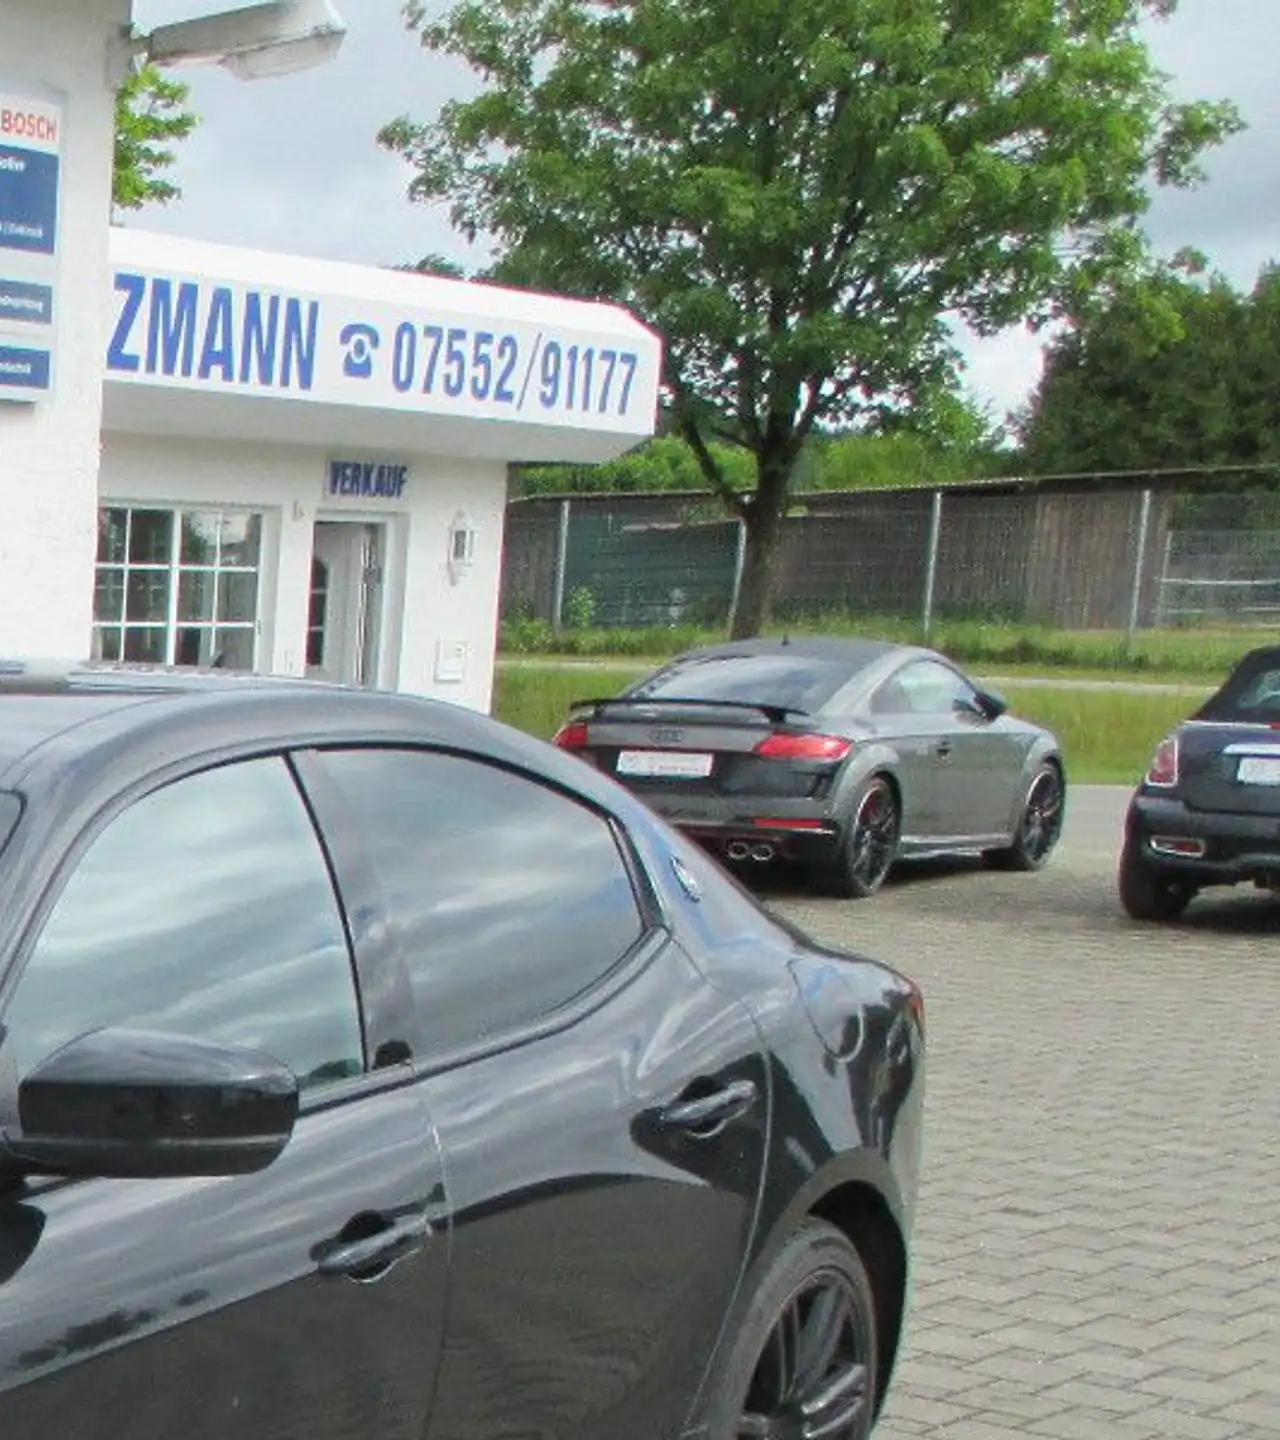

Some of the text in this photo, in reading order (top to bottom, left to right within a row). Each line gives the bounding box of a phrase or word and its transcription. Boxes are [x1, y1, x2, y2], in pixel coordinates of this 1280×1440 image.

[0, 109, 57, 142] BOSCH
[106, 272, 638, 417] ZMANN 07552/91177
[328, 461, 408, 498] VERKAUF
